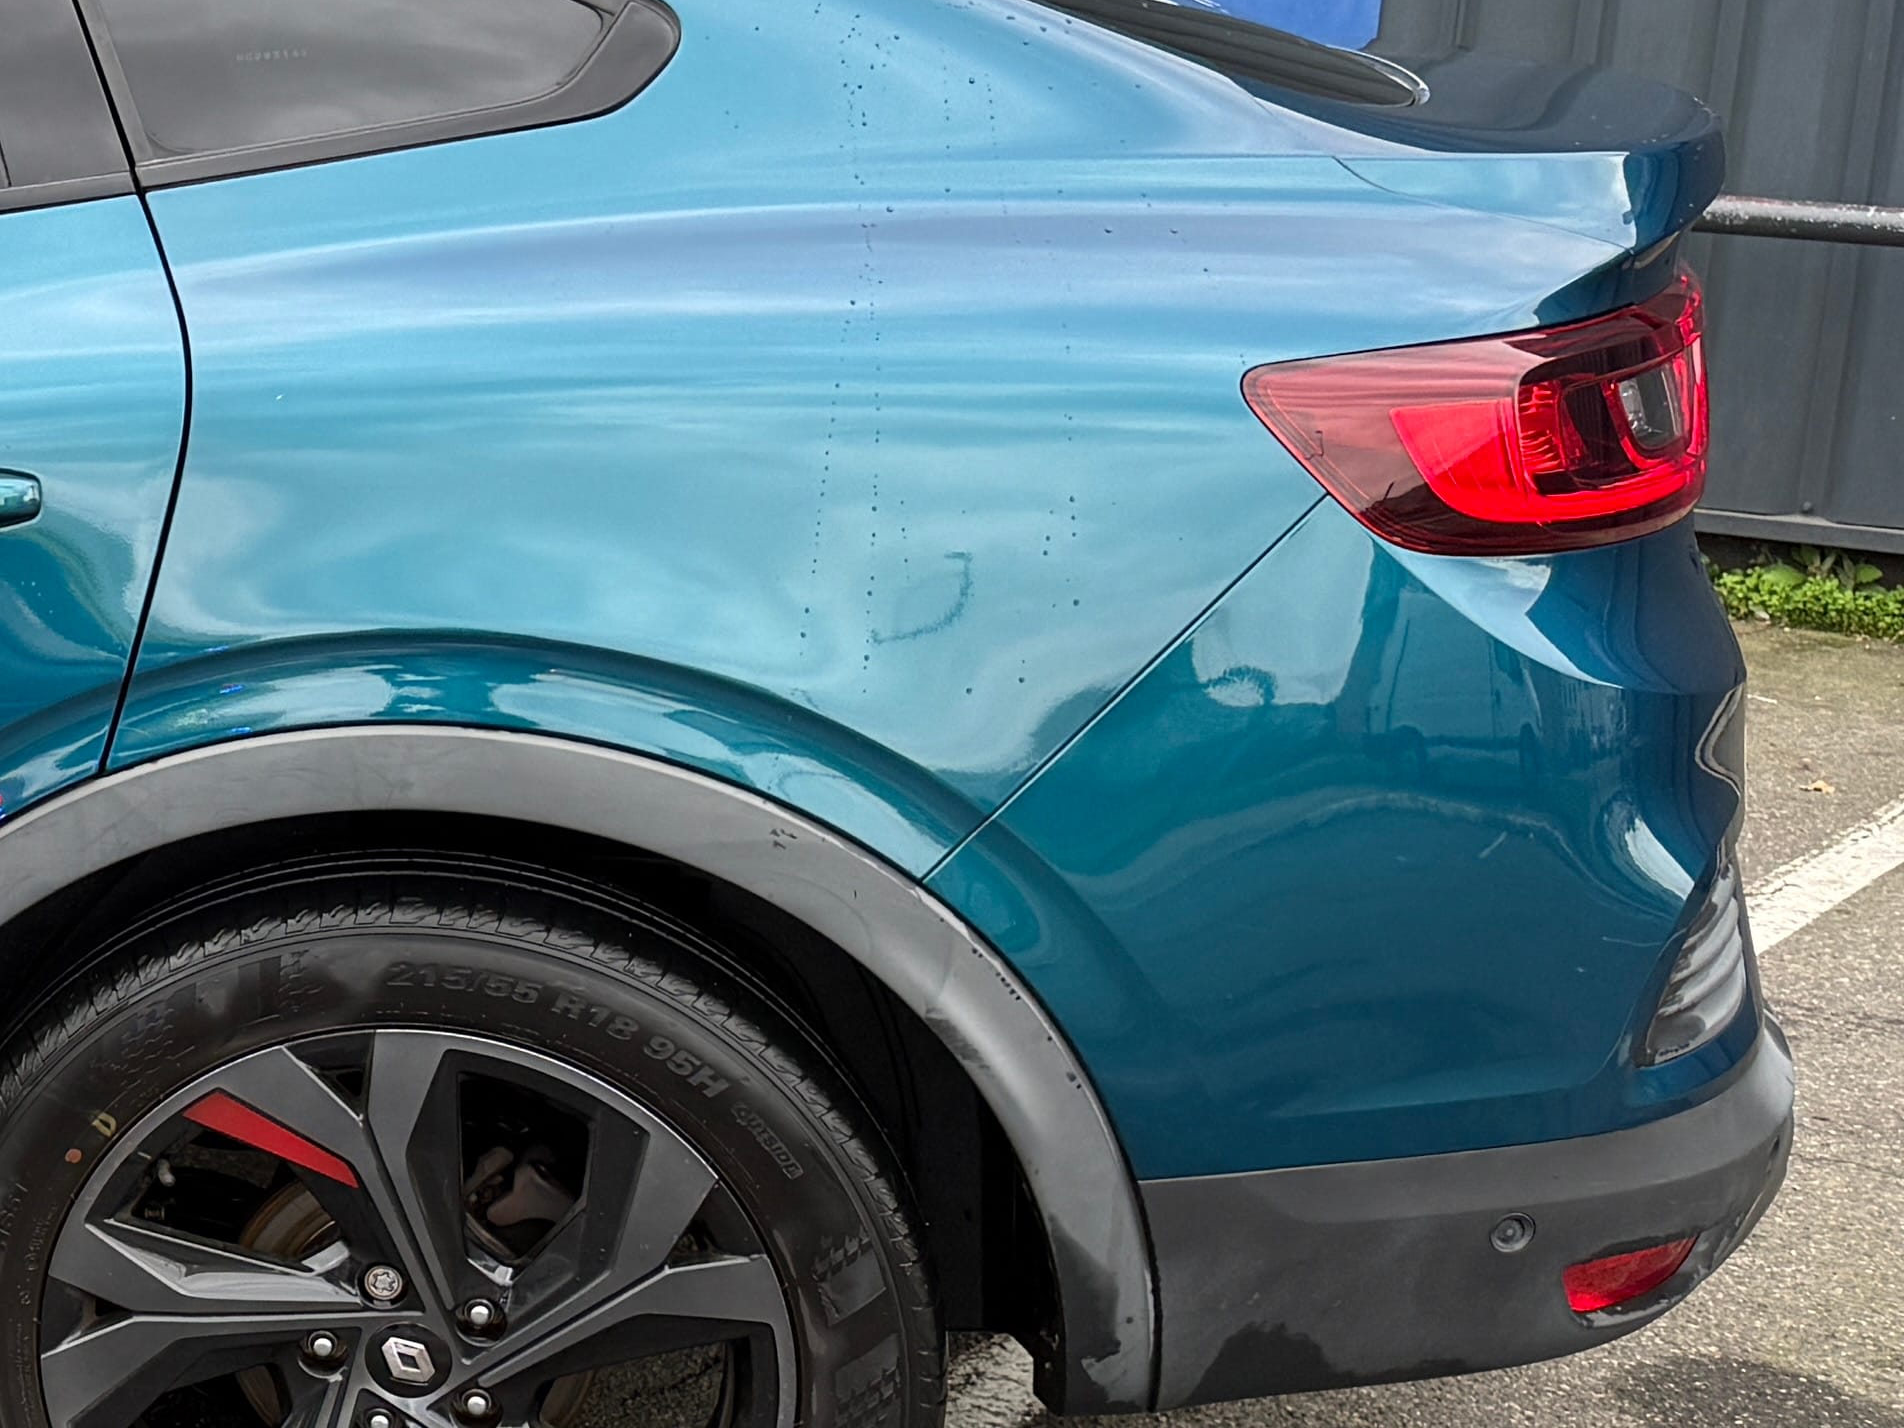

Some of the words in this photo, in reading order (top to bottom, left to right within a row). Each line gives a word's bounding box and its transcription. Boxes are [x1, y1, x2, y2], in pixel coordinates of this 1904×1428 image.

[384, 962, 543, 1005] 215/55
[551, 992, 640, 1043] R18
[641, 1034, 730, 1099] 95H
